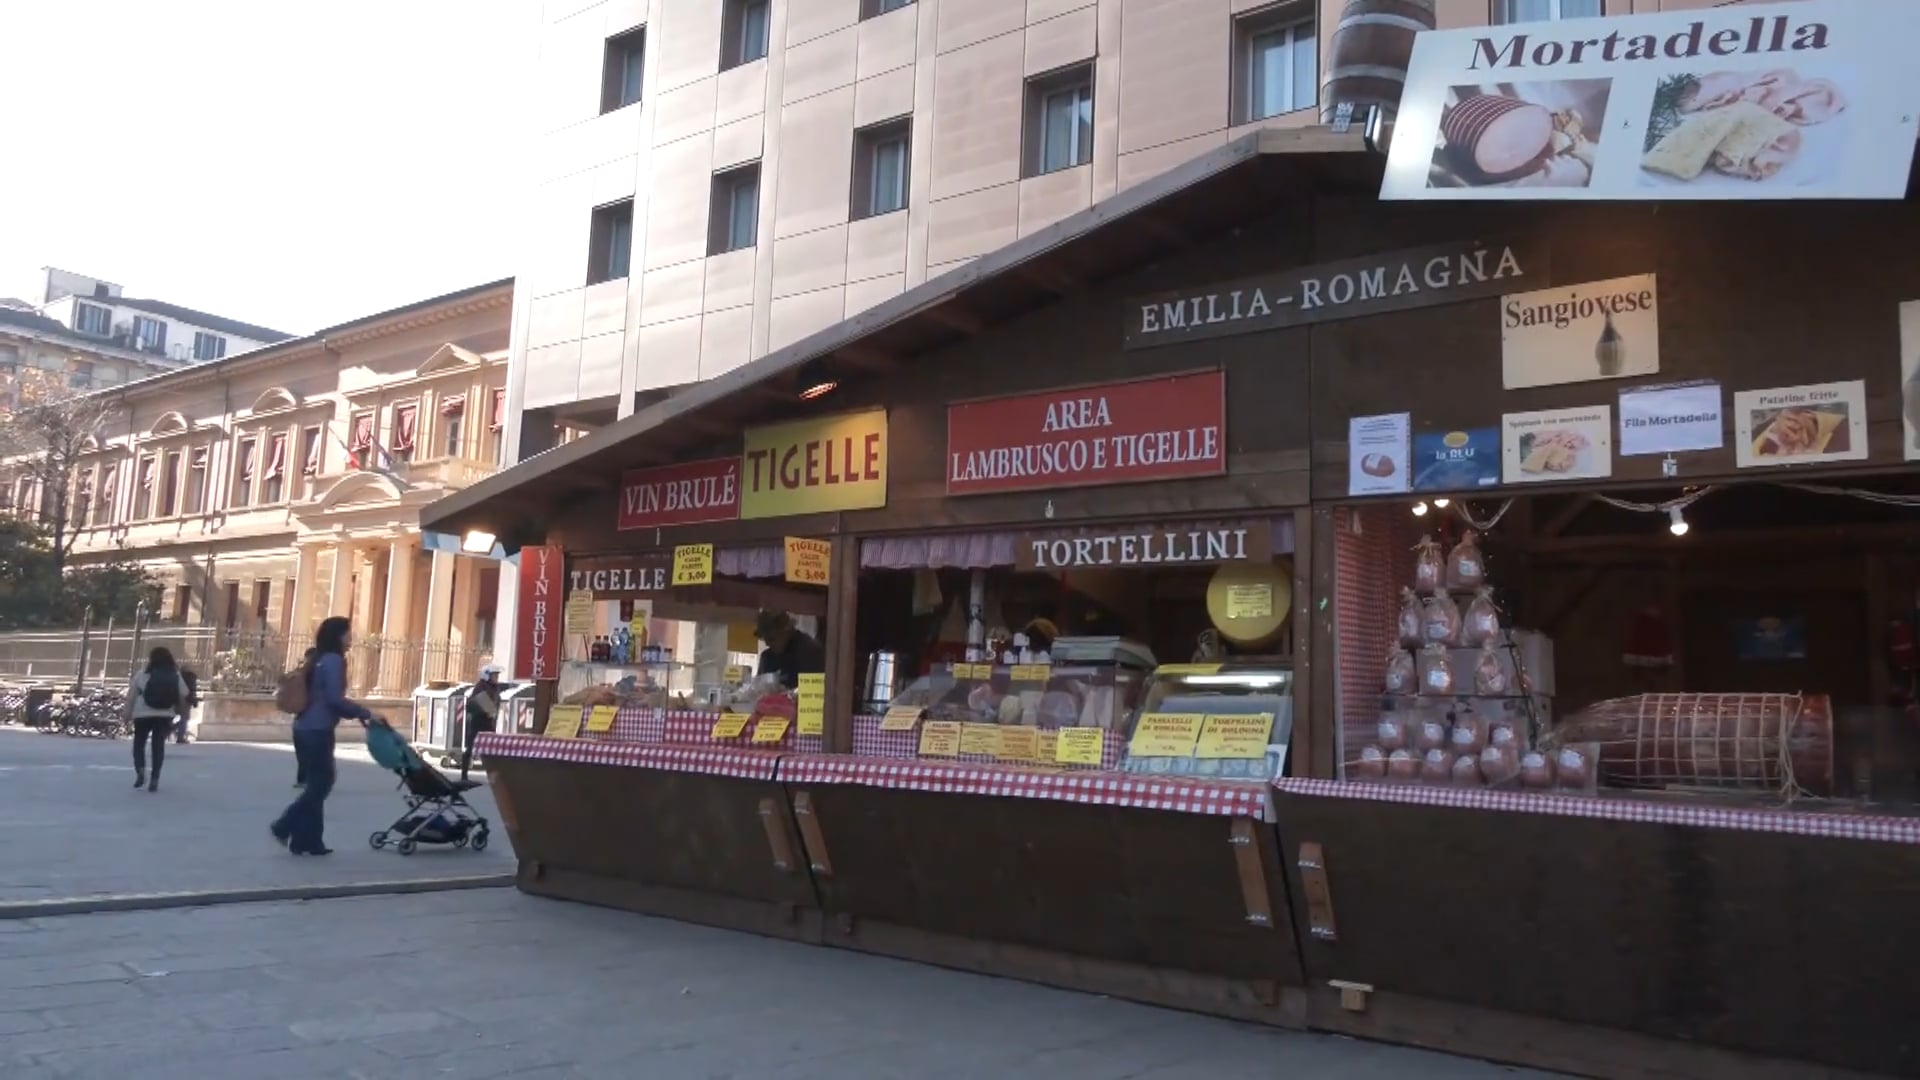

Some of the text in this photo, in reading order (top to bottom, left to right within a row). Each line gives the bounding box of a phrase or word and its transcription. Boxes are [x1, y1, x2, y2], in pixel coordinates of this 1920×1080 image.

[1466, 16, 1830, 71] Mortadella
[1141, 246, 1523, 334] EMILIA-ROMAGNA
[1505, 289, 1652, 329] Sangiovese
[1042, 397, 1112, 433] AREA
[1625, 412, 1718, 429] Fila Mortadella
[747, 432, 881, 493] TIGELLE
[952, 426, 1218, 483] LAMBRUSCO E TIGELLE
[625, 465, 736, 516] VIN BRULÉ
[676, 545, 711, 559] TIGELLE
[789, 541, 830, 556] TIGELLE
[1032, 529, 1248, 567] TORTELLINI
[534, 549, 549, 596] VIN
[570, 568, 666, 591] TIGELLE
